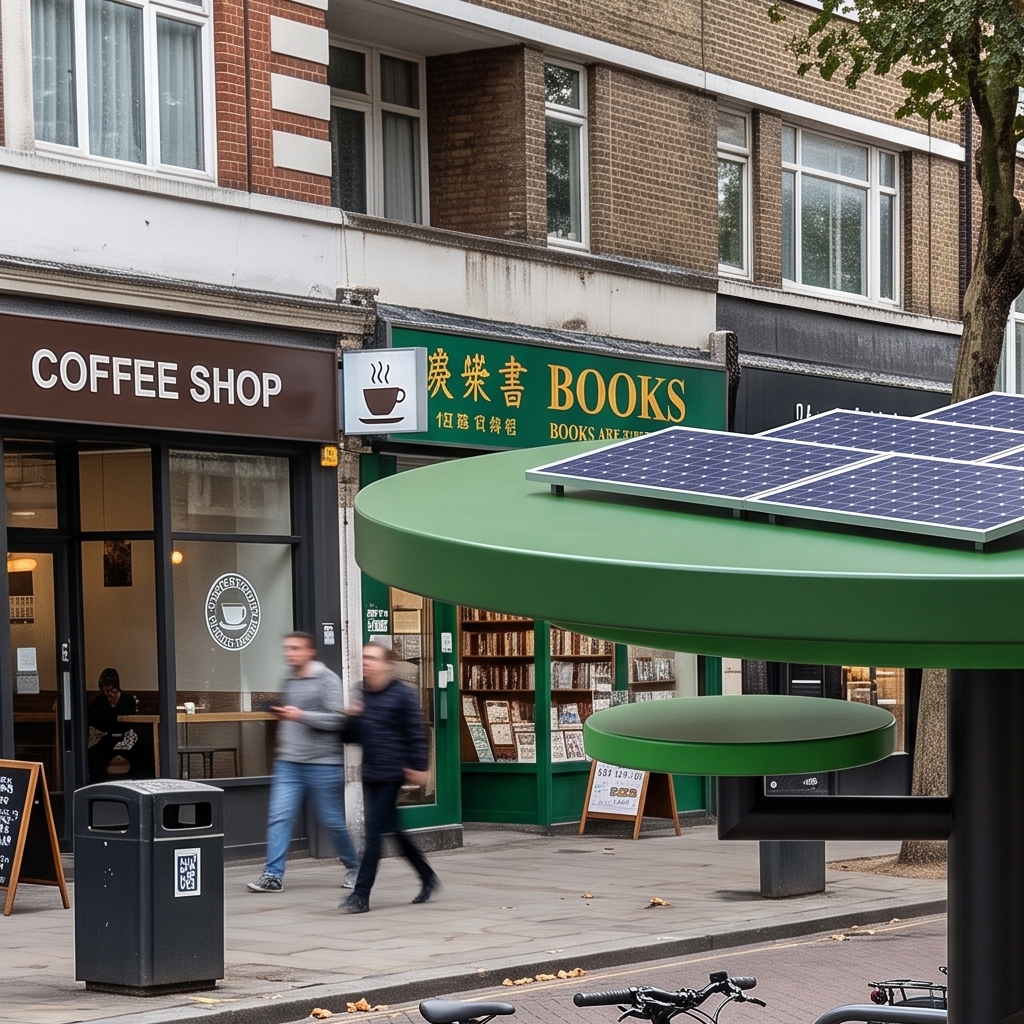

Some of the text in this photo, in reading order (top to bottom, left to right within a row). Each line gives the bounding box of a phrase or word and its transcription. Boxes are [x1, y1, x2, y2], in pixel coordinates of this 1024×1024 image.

[31, 348, 283, 408] COFFEE SHOP
[547, 363, 687, 423] BOOKS
[549, 422, 595, 441] BOOKS
[598, 428, 620, 440] ARE
